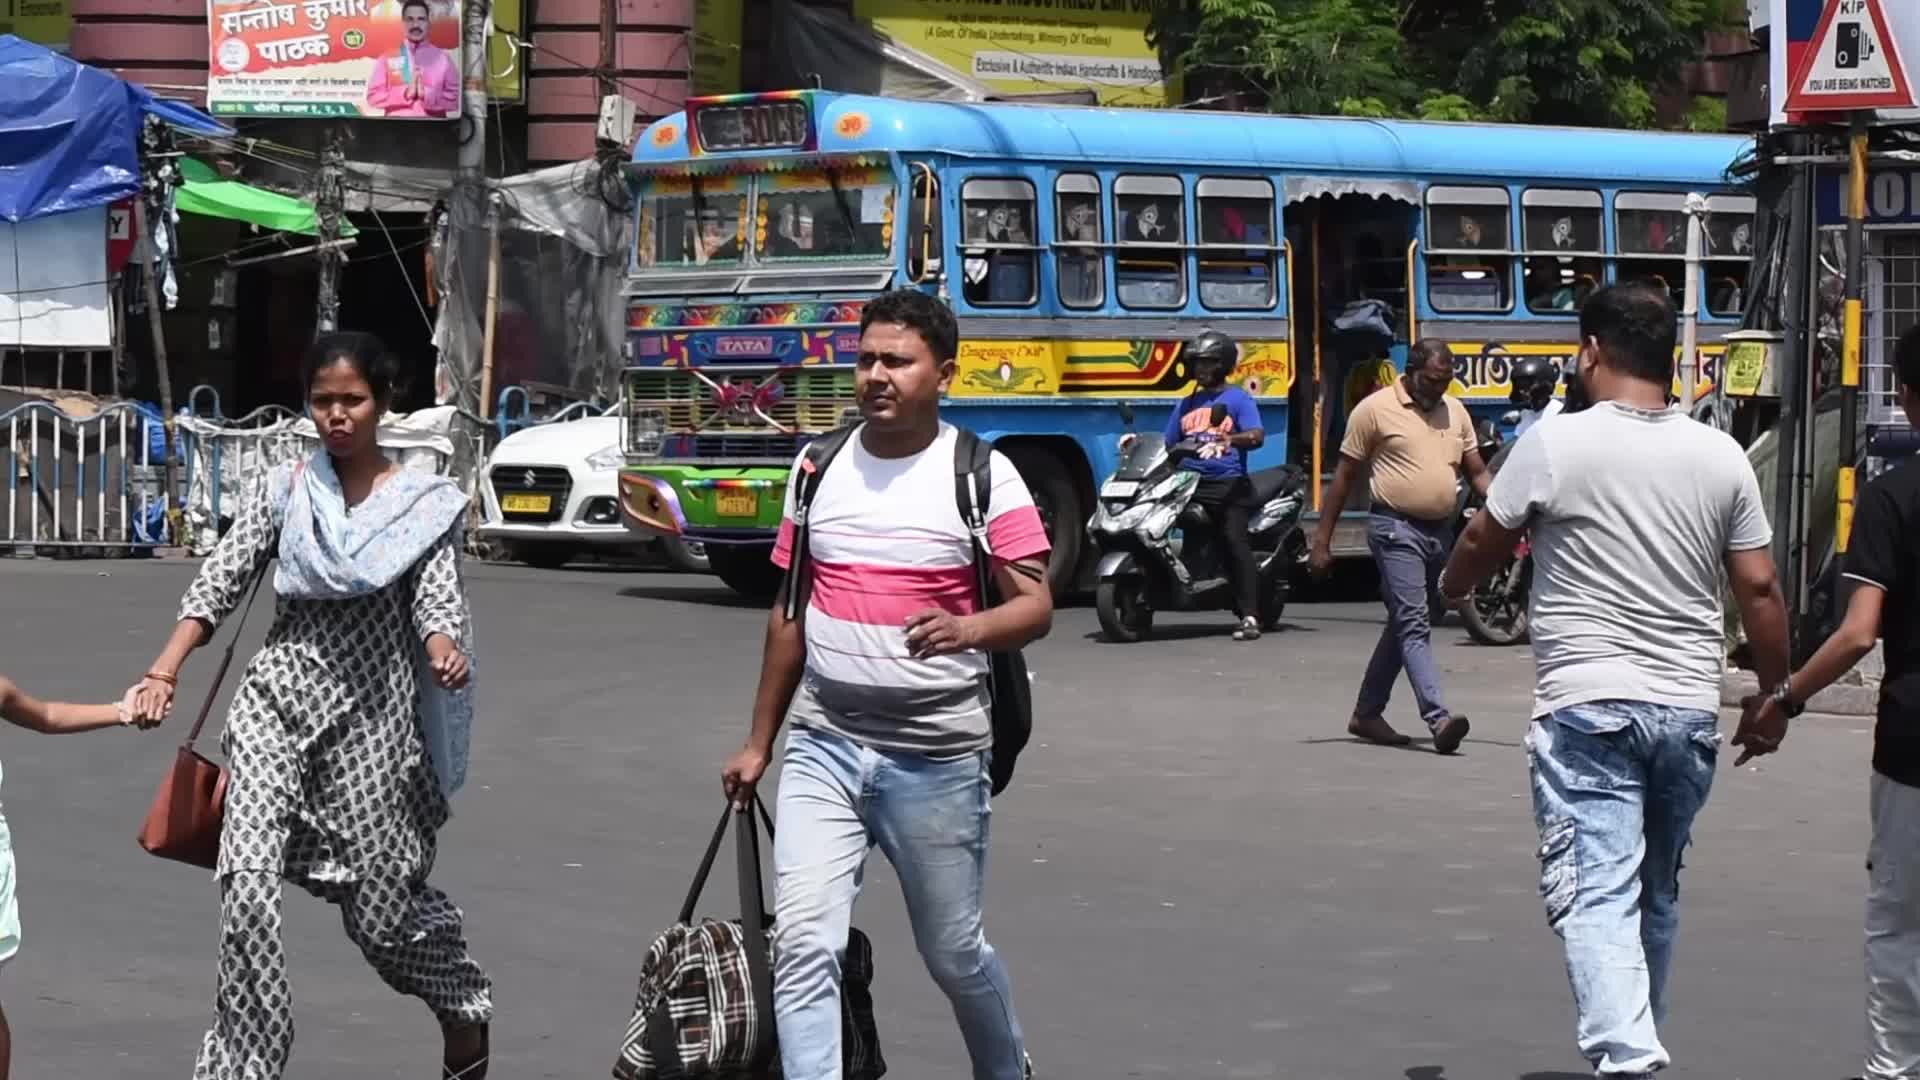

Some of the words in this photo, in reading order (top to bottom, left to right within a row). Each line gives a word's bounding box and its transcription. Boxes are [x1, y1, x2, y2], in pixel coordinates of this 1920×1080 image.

[219, 1, 297, 34] सन्तोष
[304, 0, 369, 29] कुमार
[256, 34, 331, 64] पाठक
[975, 57, 1011, 73] Exclusive
[1056, 63, 1078, 76] Indian
[1079, 63, 1119, 79] Handicrafts
[1809, 80, 1822, 91] YOU
[1824, 79, 1837, 90] ARE
[1839, 78, 1858, 90] BEING
[1860, 78, 1891, 89] WATCHED
[721, 340, 766, 351] TATA
